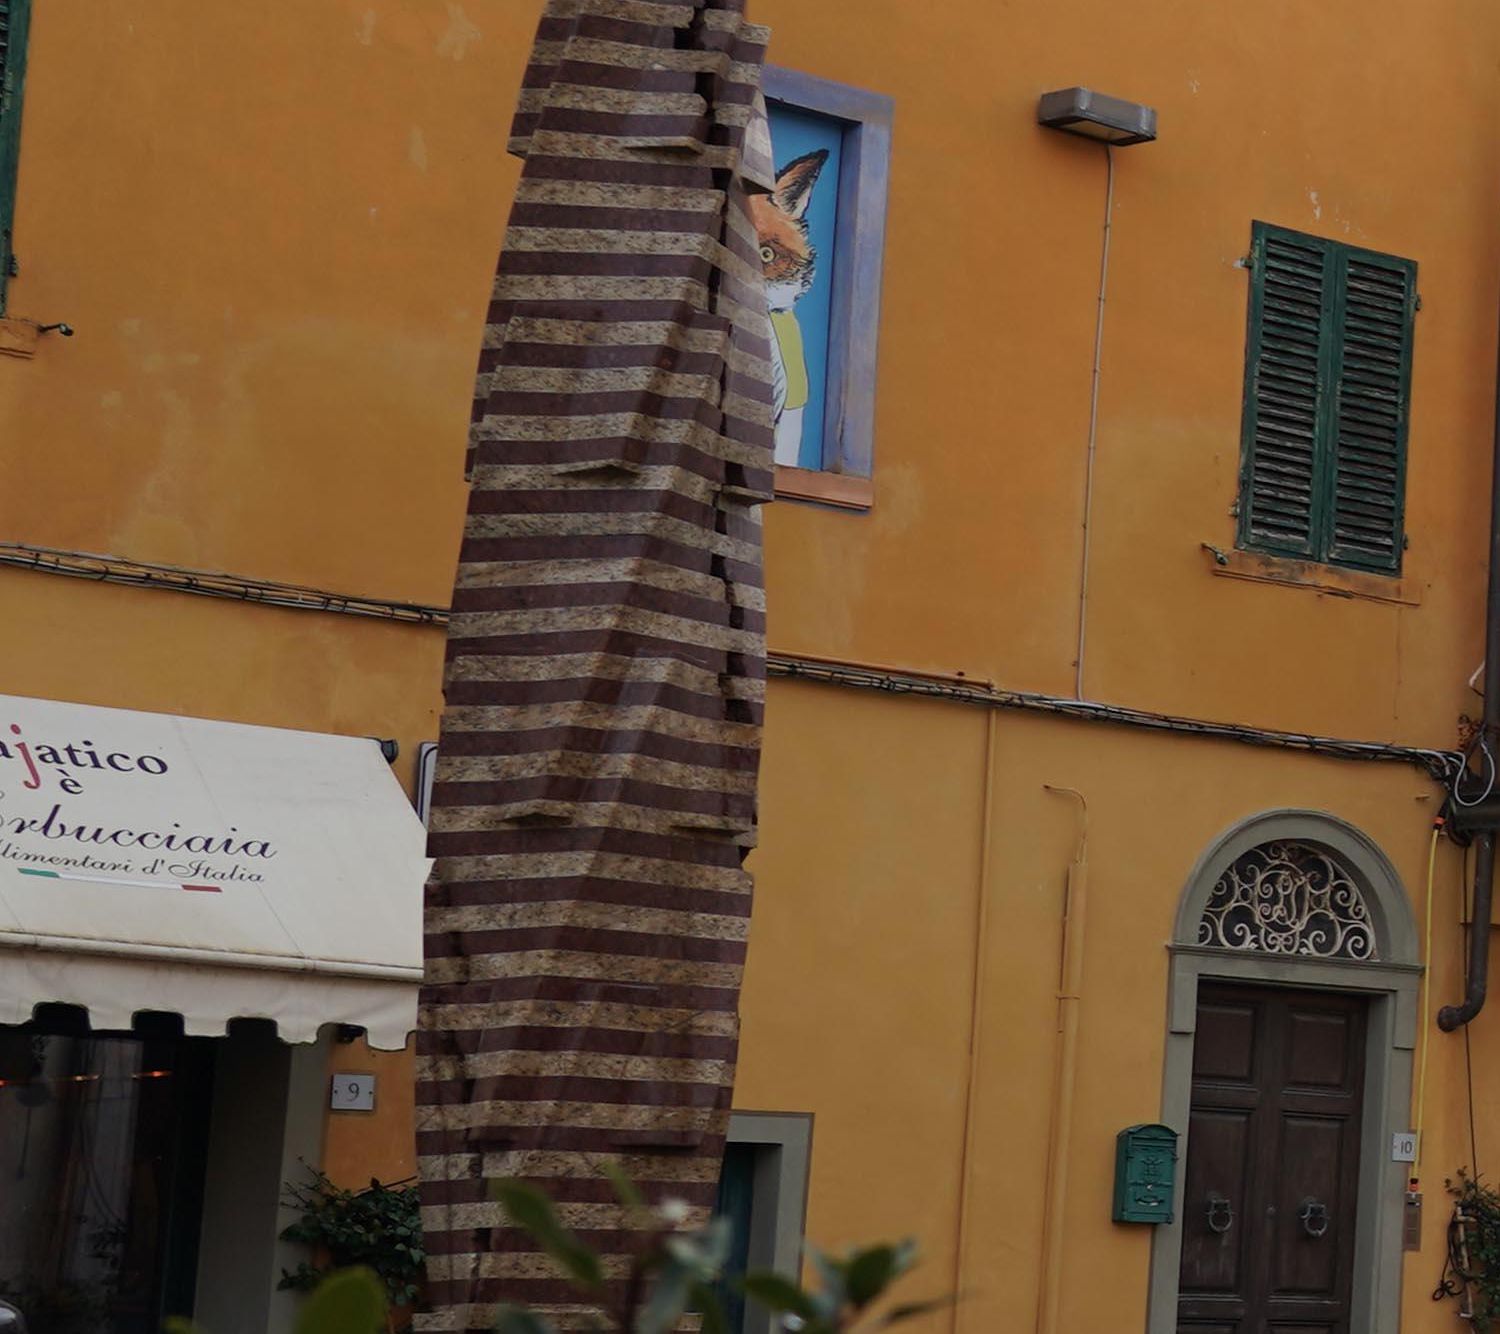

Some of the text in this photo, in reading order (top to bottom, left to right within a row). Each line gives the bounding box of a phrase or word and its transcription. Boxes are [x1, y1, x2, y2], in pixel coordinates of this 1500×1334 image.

[56, 768, 83, 794] è
[0, 790, 277, 859] rbucciaia
[0, 839, 135, 873] limentari
[348, 1082, 360, 1102] 9
[1400, 1140, 1413, 1155] 10
